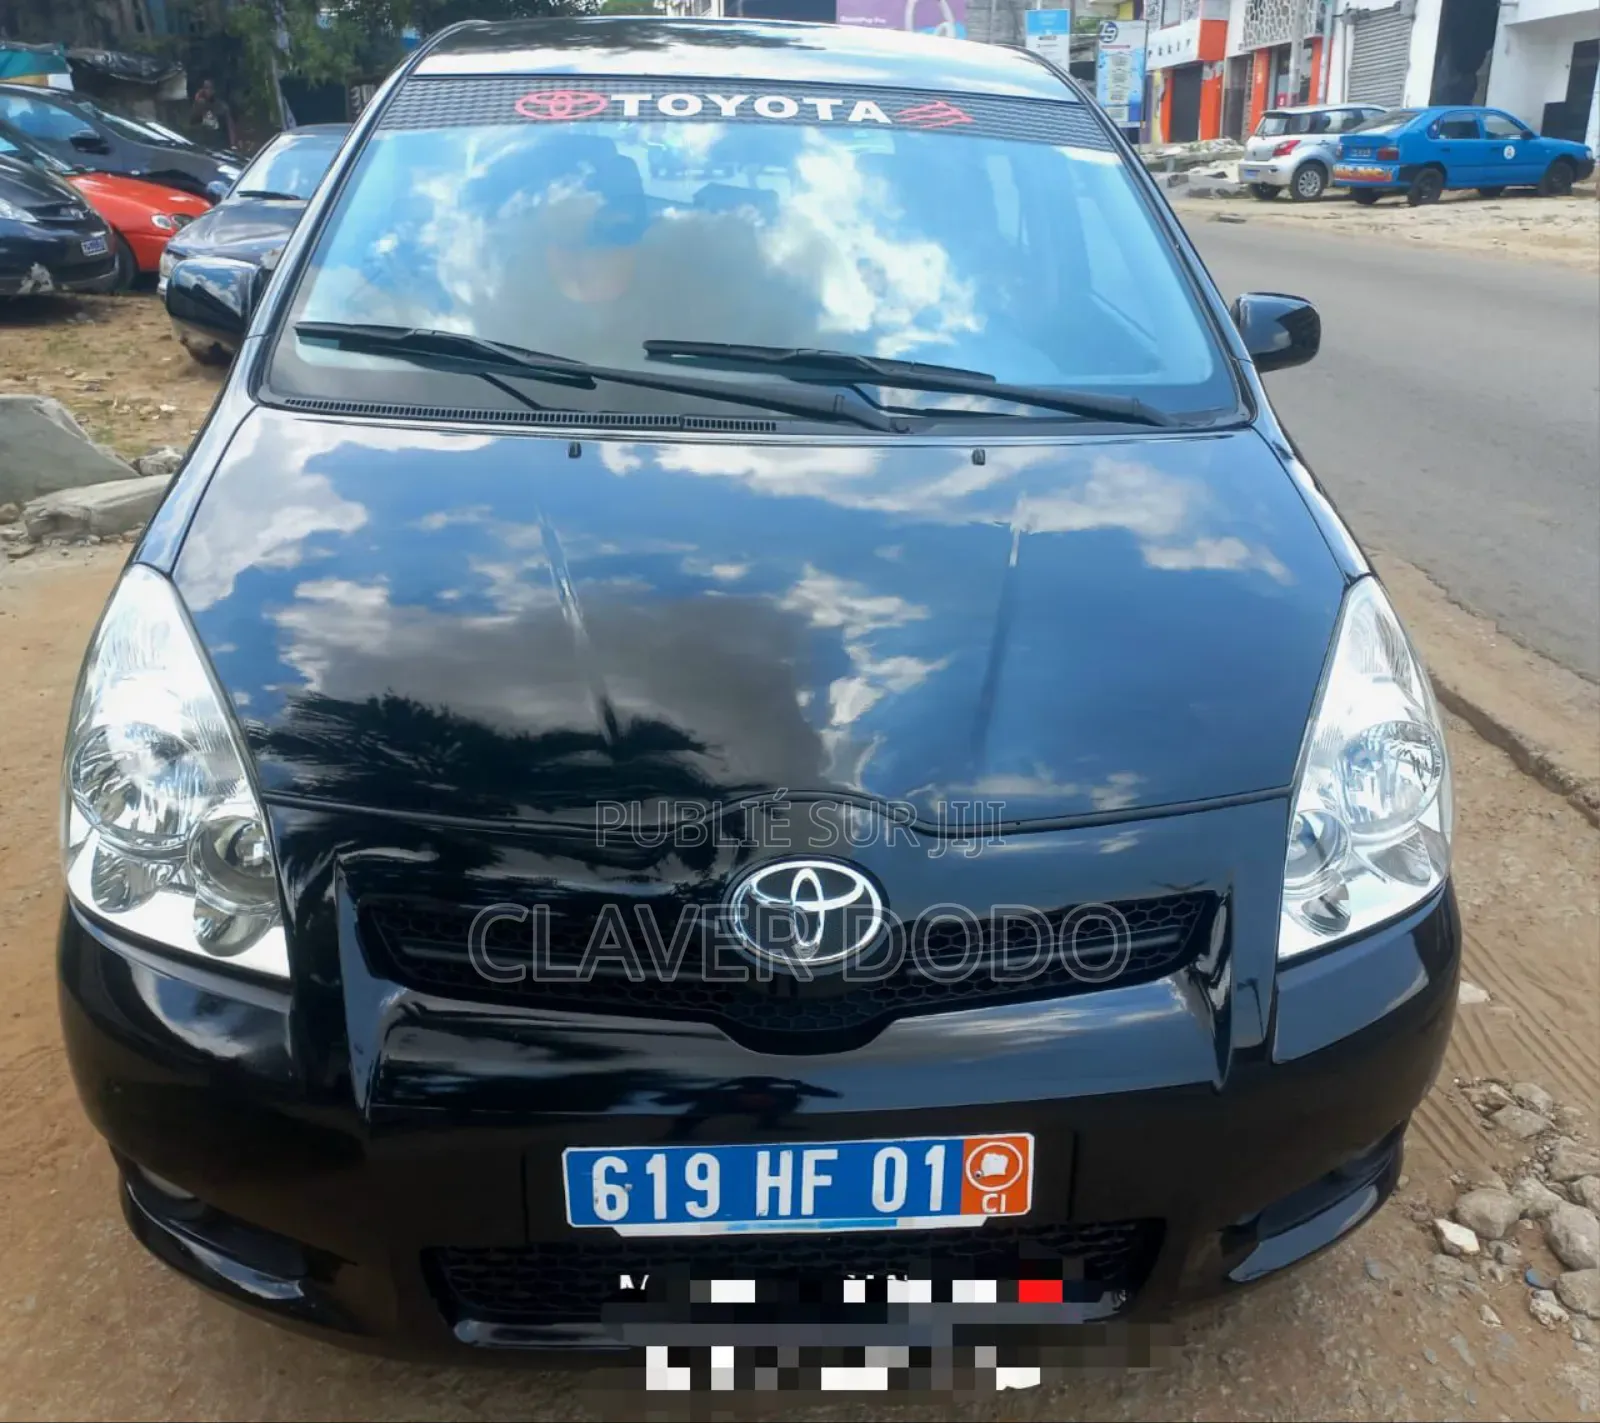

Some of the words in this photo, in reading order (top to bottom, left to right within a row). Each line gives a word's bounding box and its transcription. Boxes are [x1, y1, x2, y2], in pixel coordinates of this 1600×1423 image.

[611, 92, 891, 124] TOYOTA
[592, 1153, 720, 1221] 619
[756, 1149, 839, 1216] HF
[872, 1145, 946, 1213] 01
[981, 1193, 1007, 1213] CI
